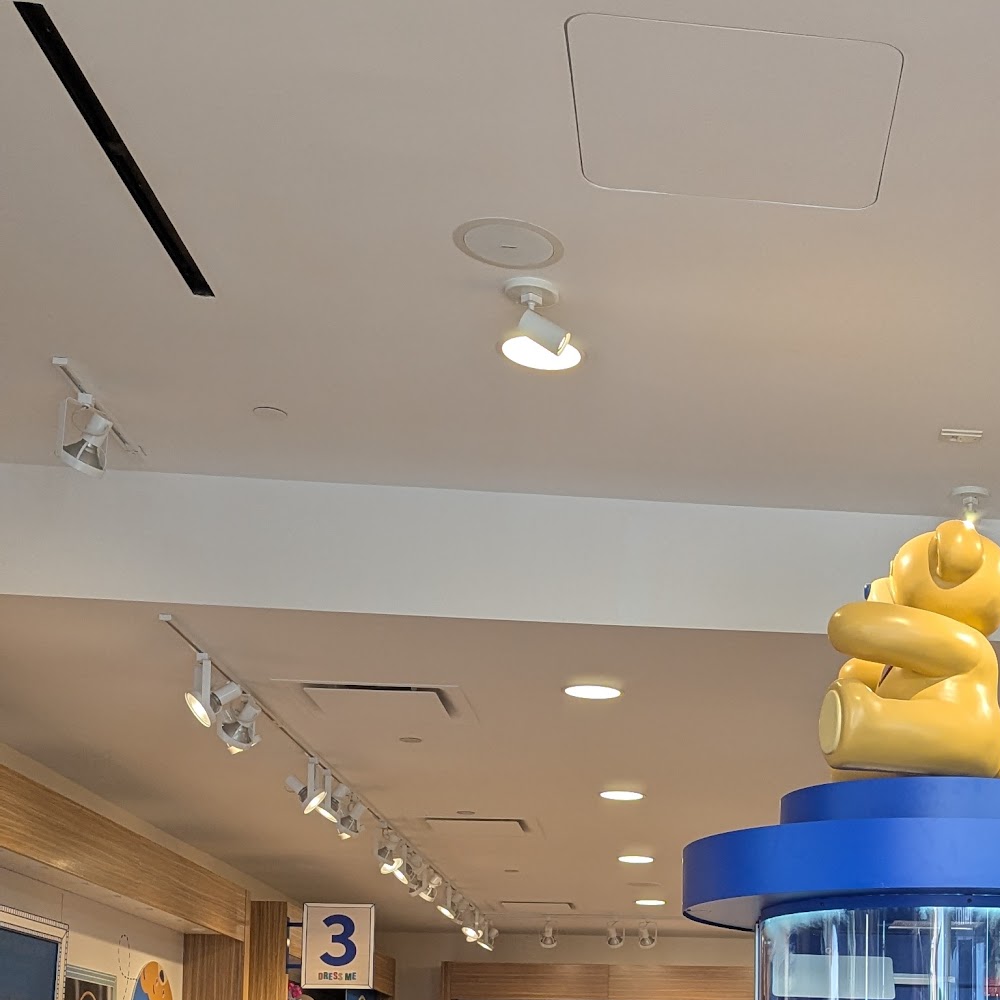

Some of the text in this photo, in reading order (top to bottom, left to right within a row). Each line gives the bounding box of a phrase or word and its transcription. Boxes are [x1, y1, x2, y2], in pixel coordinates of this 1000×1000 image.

[319, 914, 357, 966] 3
[318, 971, 357, 981] DRESS ME
